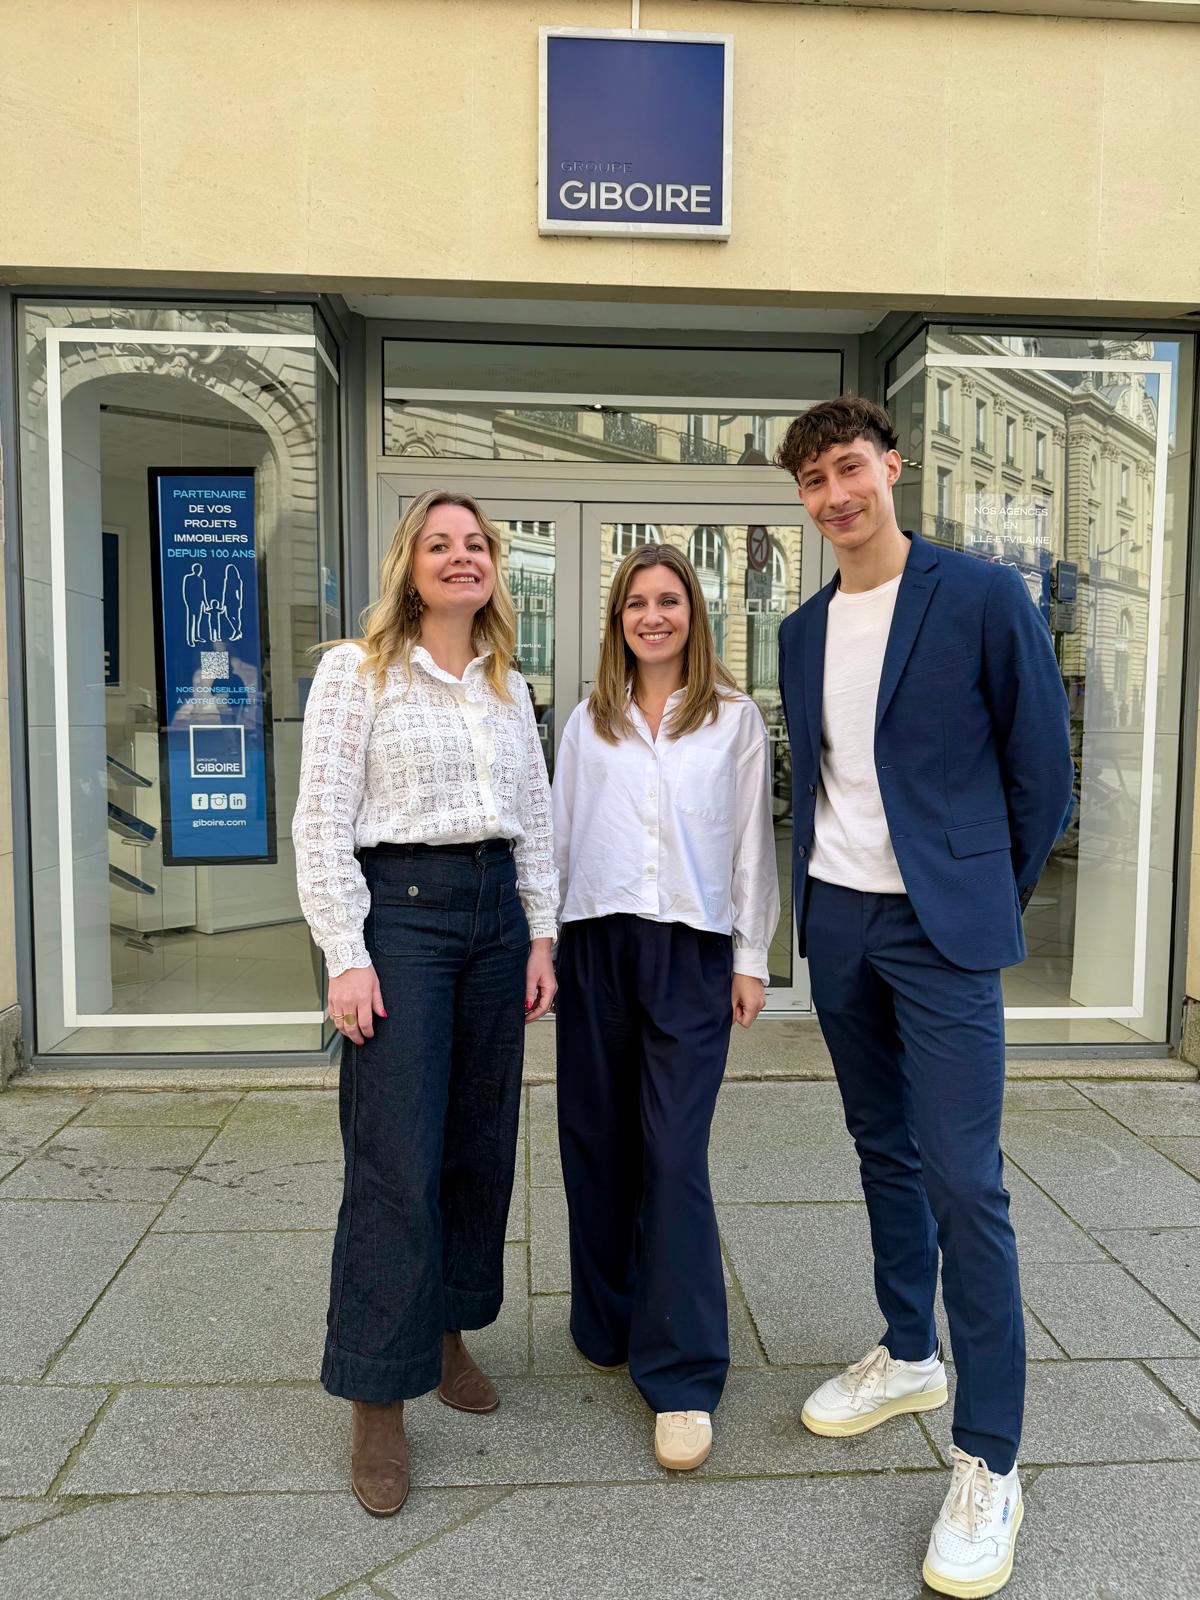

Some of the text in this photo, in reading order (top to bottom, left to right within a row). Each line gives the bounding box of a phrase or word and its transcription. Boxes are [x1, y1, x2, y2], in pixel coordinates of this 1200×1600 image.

[561, 160, 633, 174] GROUPE
[559, 180, 711, 213] GIBOIRE
[173, 489, 247, 499] PARTENAIRE
[189, 504, 232, 514] DE VOS
[974, 506, 1049, 516] NOS AGENCES
[184, 519, 237, 528] PROJETS
[174, 534, 249, 543] IMMOBILIERS
[167, 548, 256, 559] DEPUIS 100 ANS
[185, 697, 214, 705] VOTRE
[196, 763, 241, 773] GIBOIRE
[192, 818, 247, 828] giboire.com
